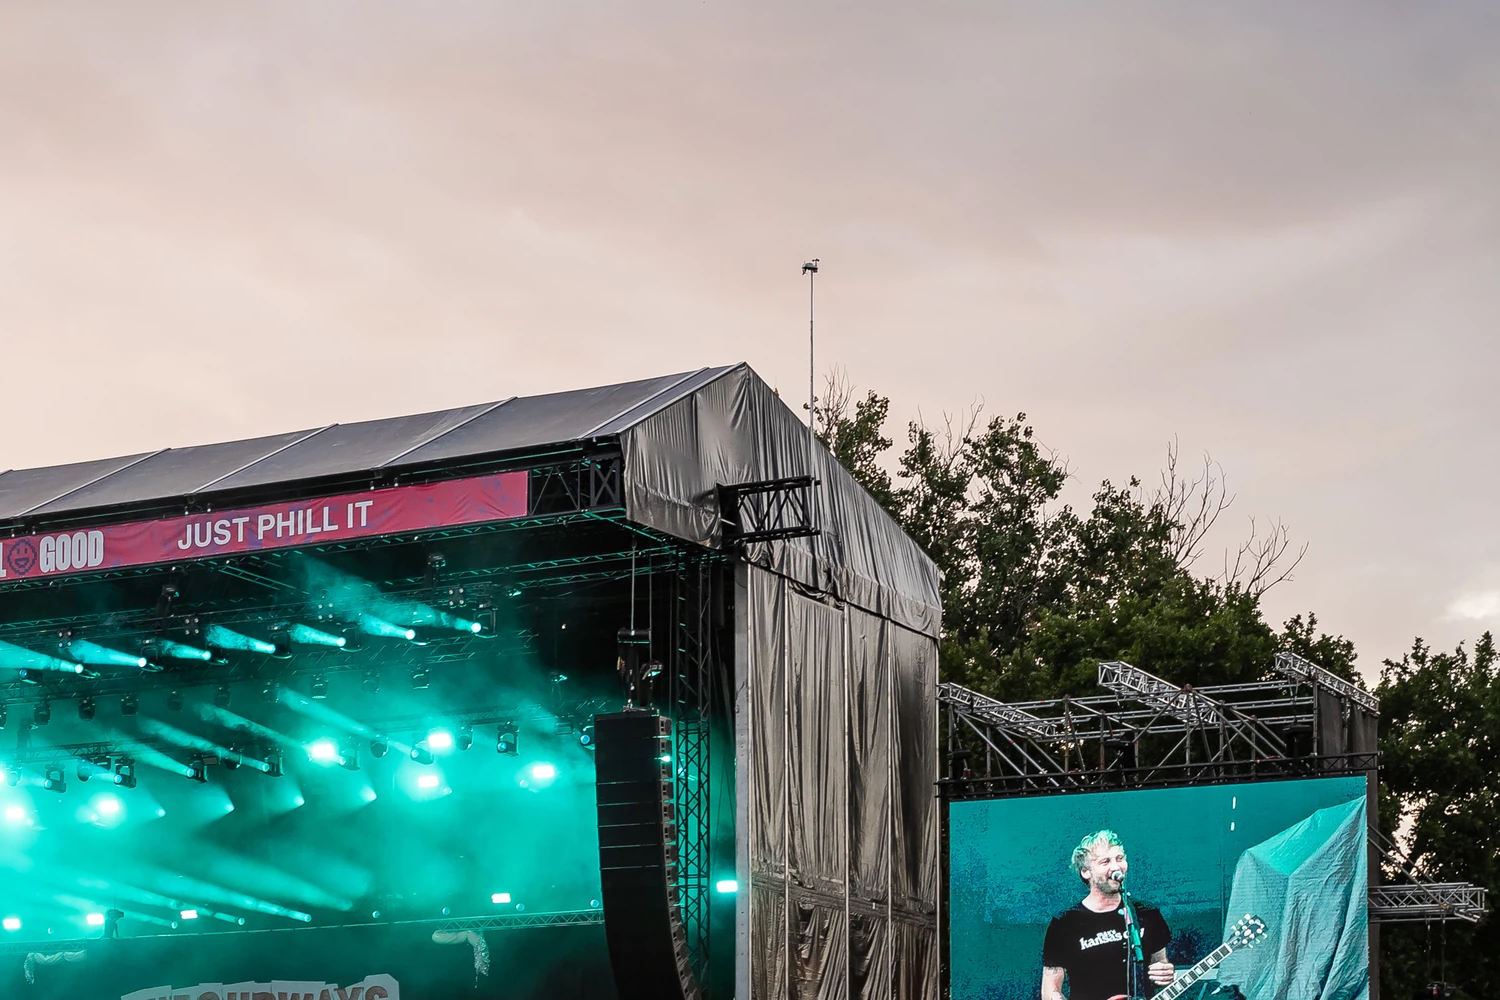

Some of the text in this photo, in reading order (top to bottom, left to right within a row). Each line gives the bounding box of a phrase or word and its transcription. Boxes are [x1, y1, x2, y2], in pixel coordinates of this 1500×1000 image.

[177, 500, 374, 550] JUST PHILL IT
[39, 530, 105, 573] GOOD
